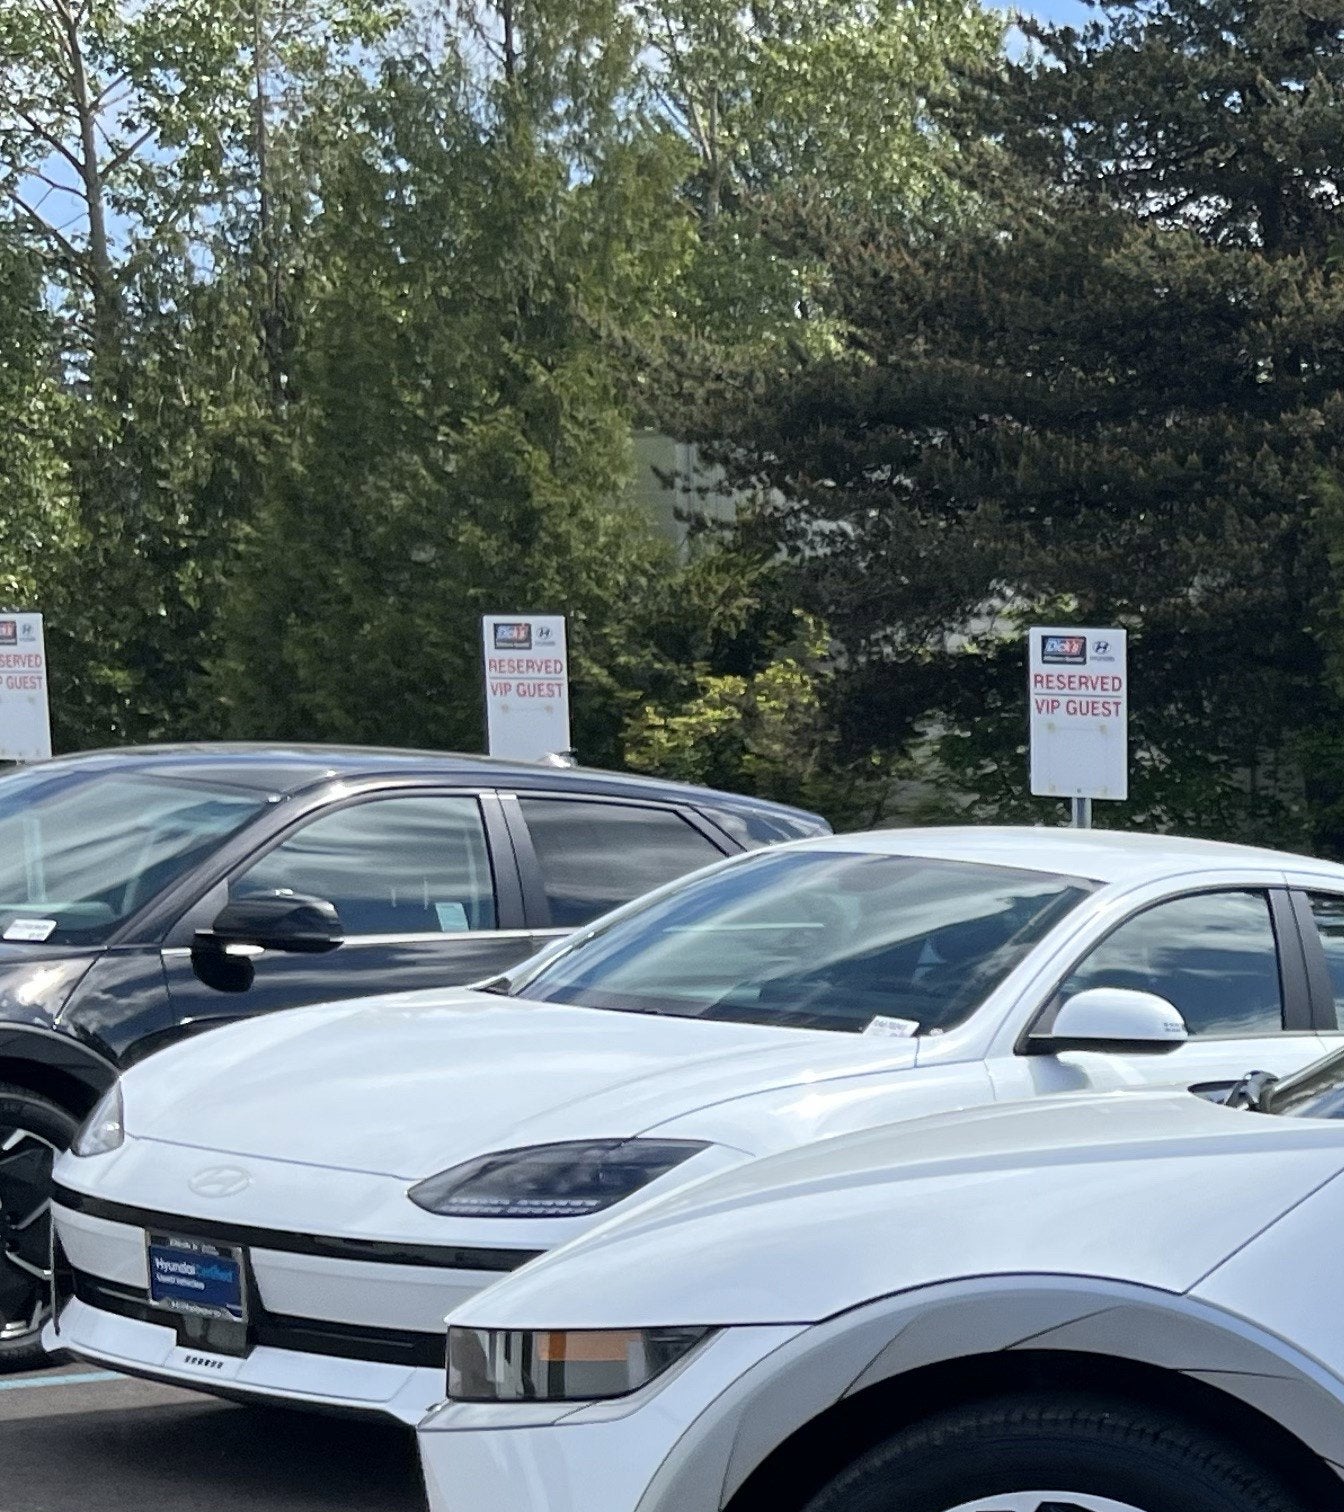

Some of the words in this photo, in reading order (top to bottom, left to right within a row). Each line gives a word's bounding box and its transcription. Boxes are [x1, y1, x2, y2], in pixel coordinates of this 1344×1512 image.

[488, 658, 563, 675] RESERVED
[6, 676, 43, 690] GUEST
[490, 682, 512, 696] VIP
[516, 682, 563, 698] GUEST
[1033, 673, 1122, 692] RESERVED
[1035, 699, 1060, 715] VIP
[1066, 700, 1122, 717] GUEST
